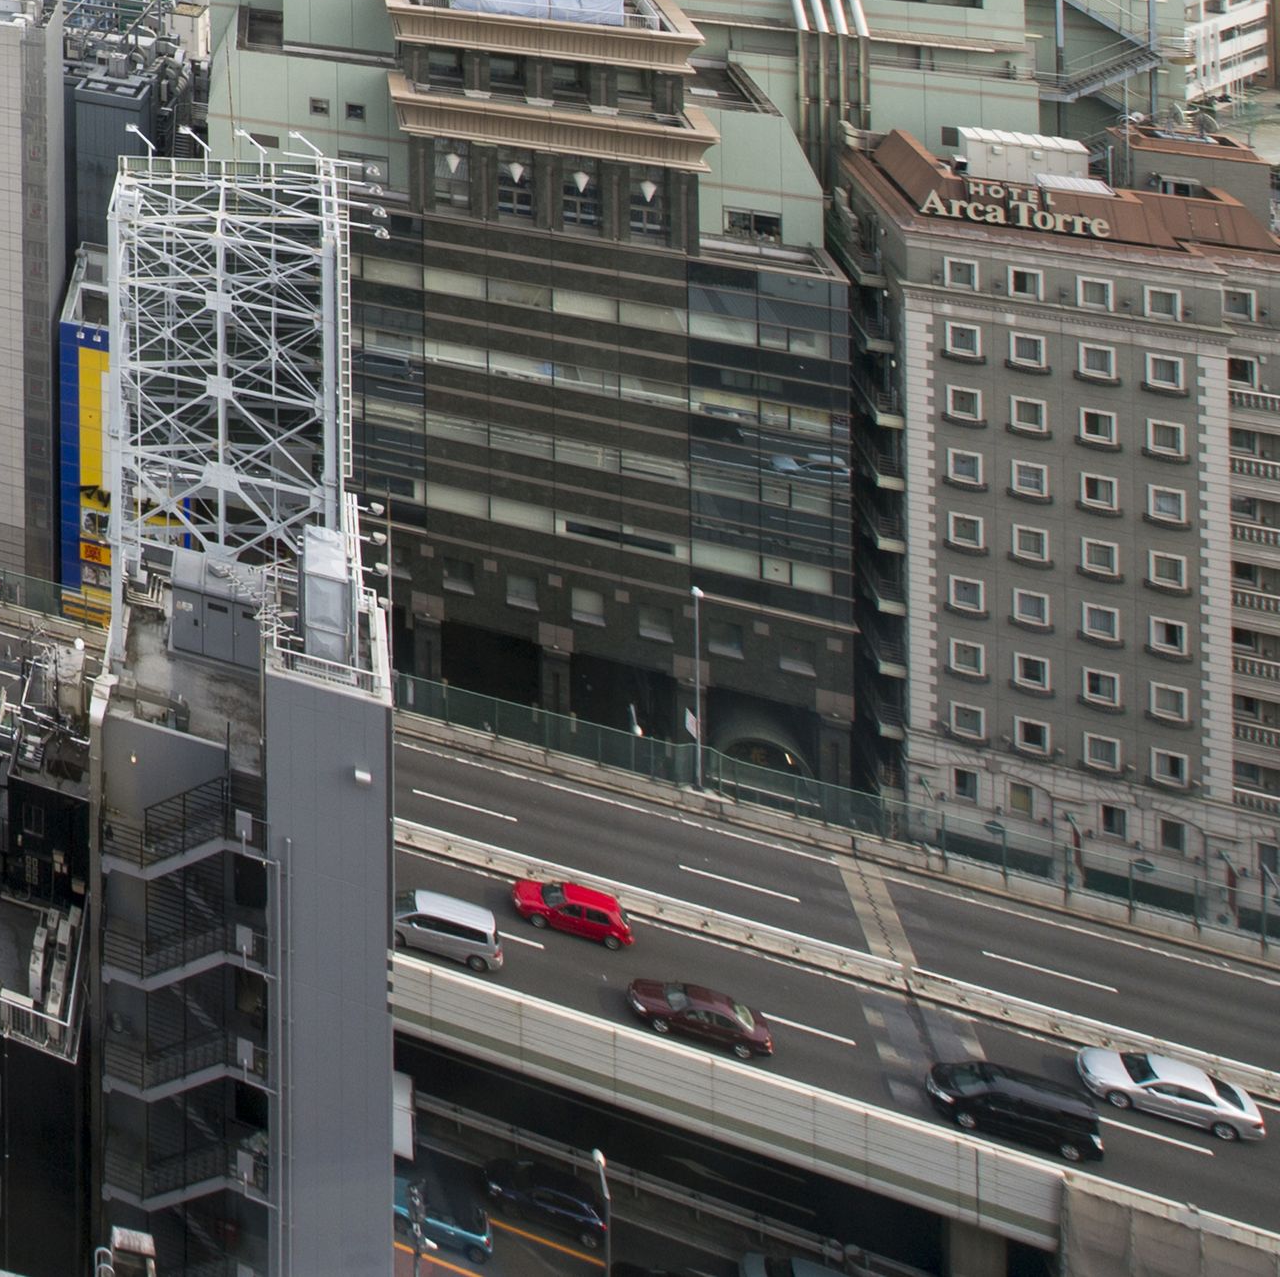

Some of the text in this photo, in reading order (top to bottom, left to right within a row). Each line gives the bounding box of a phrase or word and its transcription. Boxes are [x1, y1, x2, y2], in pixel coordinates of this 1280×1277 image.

[968, 181, 1056, 206] HOTEL
[920, 189, 1111, 238] Arca Torre
